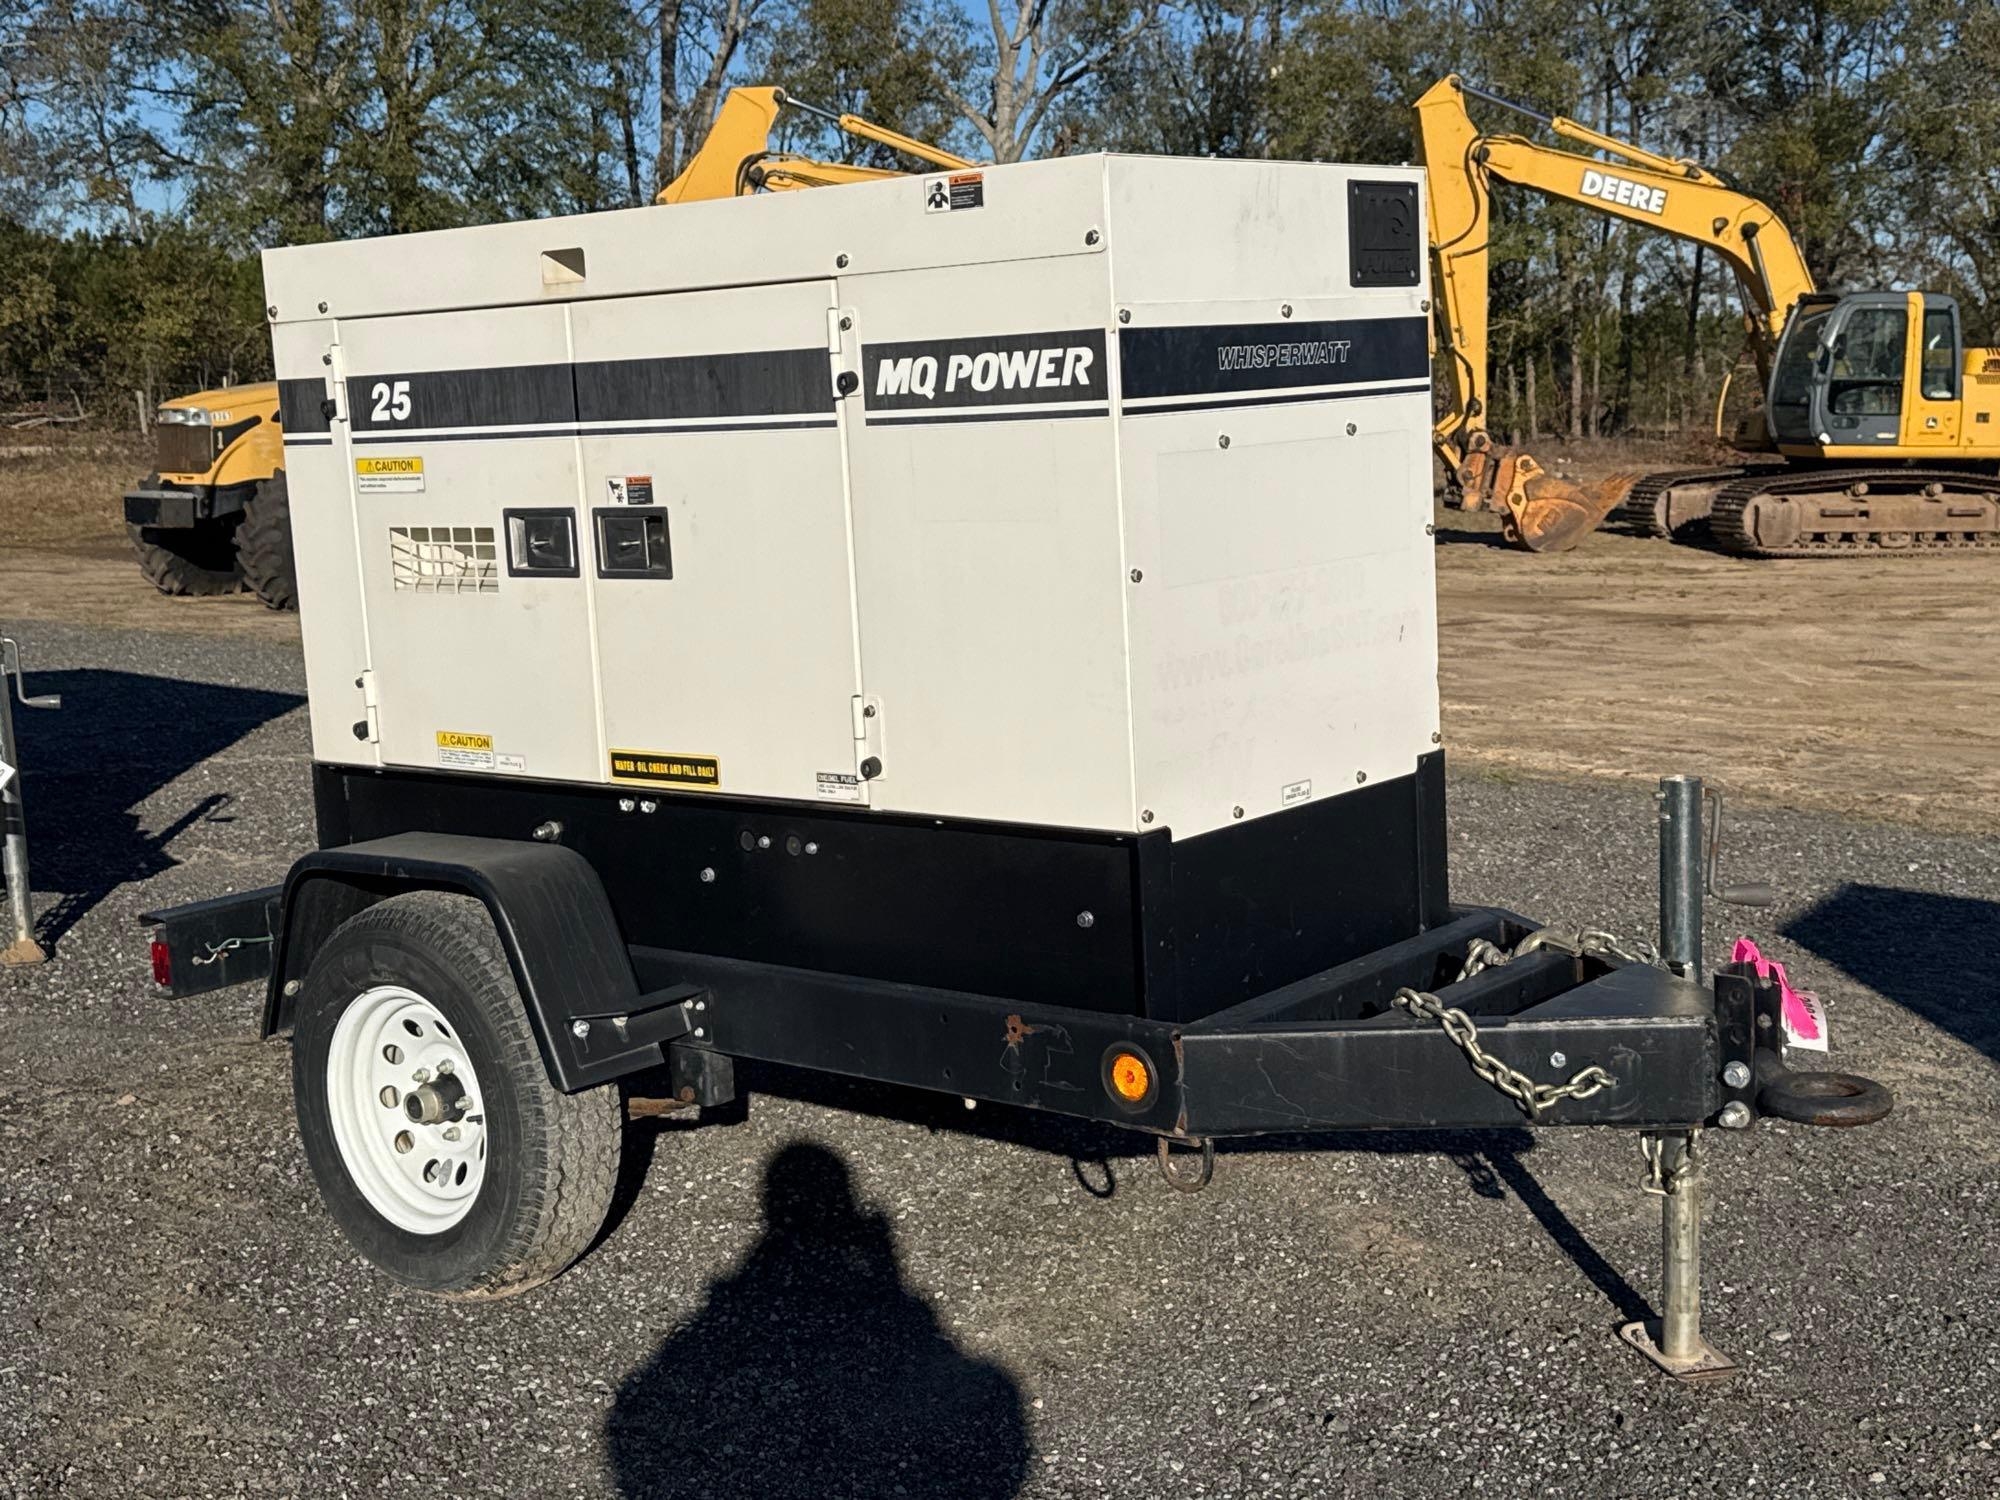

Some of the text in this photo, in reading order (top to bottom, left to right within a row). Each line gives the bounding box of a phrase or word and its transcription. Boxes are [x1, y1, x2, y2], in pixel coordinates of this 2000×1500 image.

[1581, 170, 1667, 214] DEERE
[1218, 340, 1351, 370] WHISPERWATT
[875, 346, 1094, 400] MQ POWER
[371, 381, 411, 421] 25
[374, 460, 413, 472] CAUTION
[449, 735, 490, 748] CAUTION
[682, 765, 697, 777] FILL
